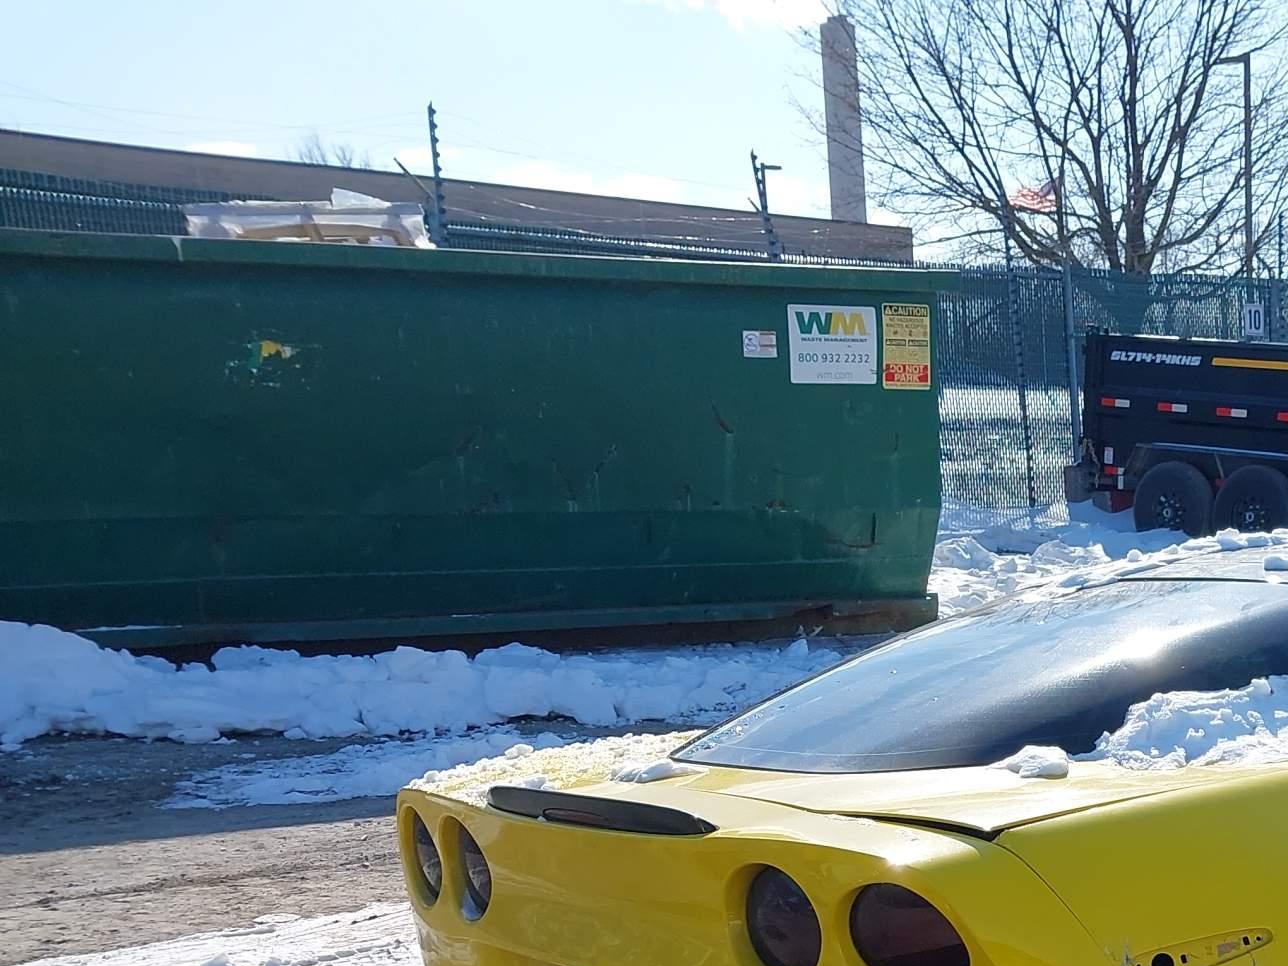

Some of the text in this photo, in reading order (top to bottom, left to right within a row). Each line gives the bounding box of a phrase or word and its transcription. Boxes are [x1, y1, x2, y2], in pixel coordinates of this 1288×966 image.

[891, 305, 928, 316] CAUTION
[795, 311, 867, 336] WM
[1248, 309, 1261, 330] 10
[798, 352, 870, 364] 800 932 2232
[889, 364, 926, 374] DO NOT
[894, 373, 920, 382] PARK
